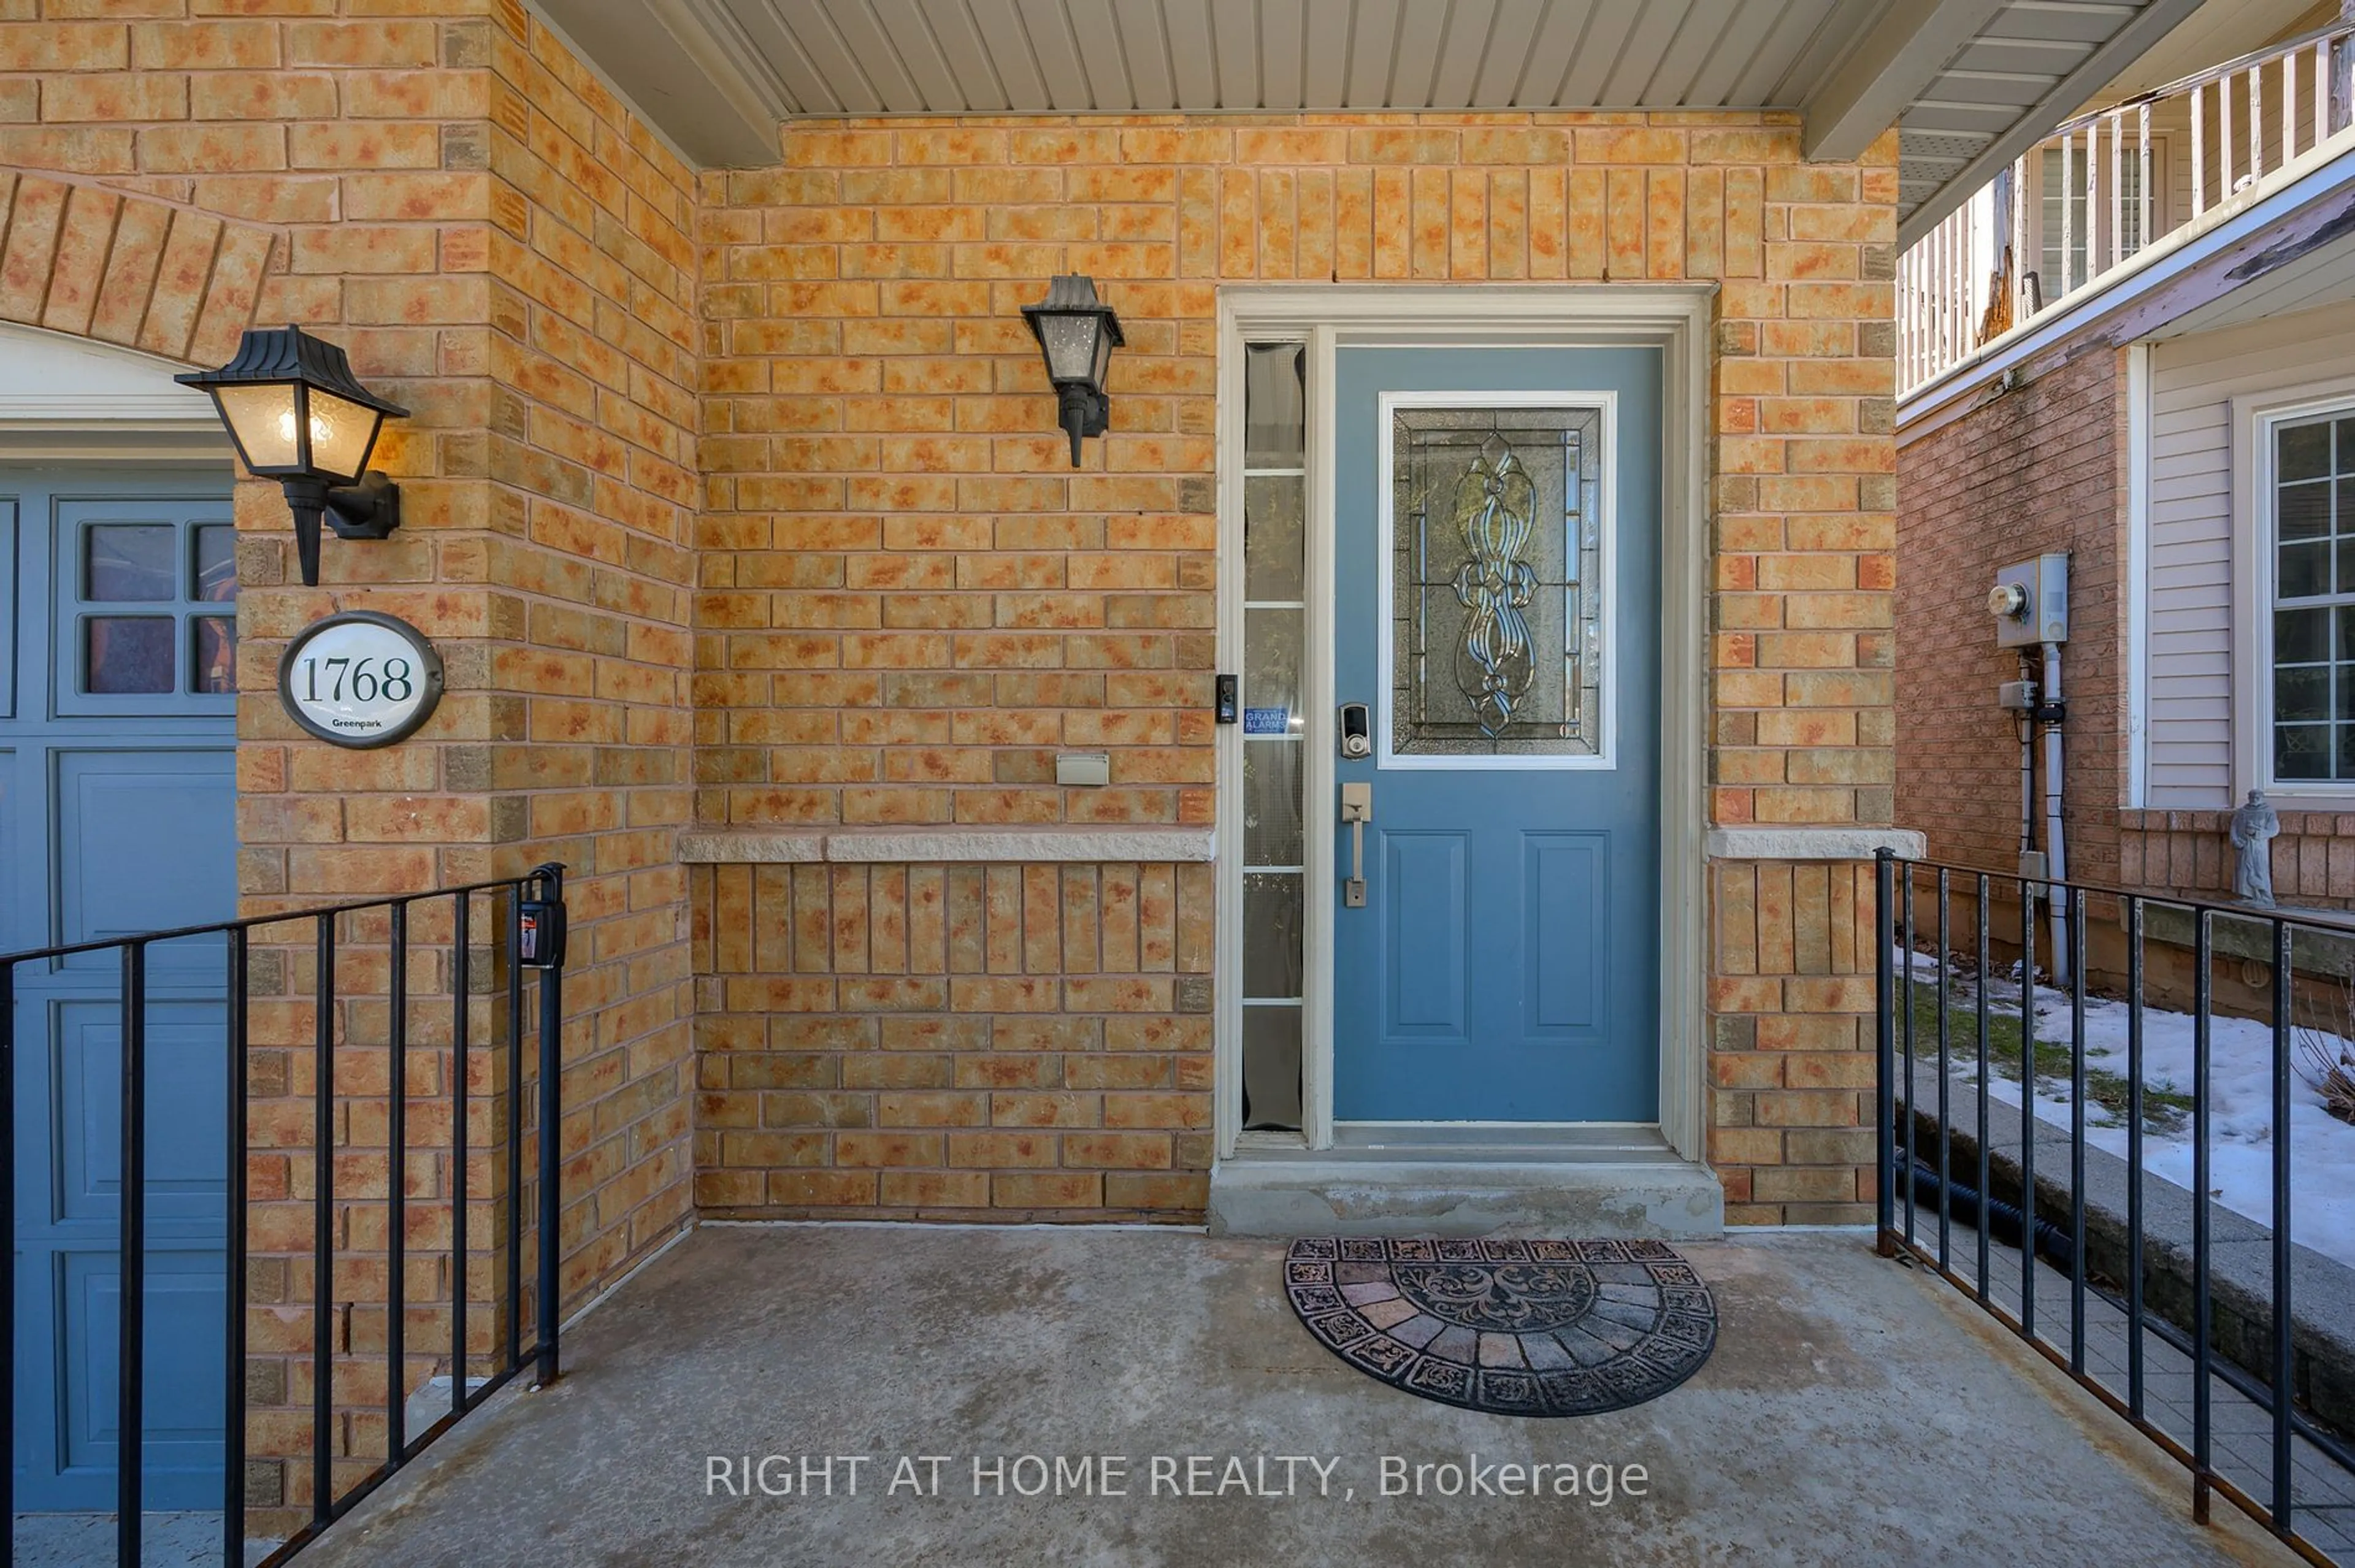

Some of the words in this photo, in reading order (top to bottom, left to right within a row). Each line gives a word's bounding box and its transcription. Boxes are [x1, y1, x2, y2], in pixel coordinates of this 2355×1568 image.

[302, 657, 412, 702] 1768
[1246, 712, 1285, 721] GRAND
[332, 718, 382, 730] Greenpark
